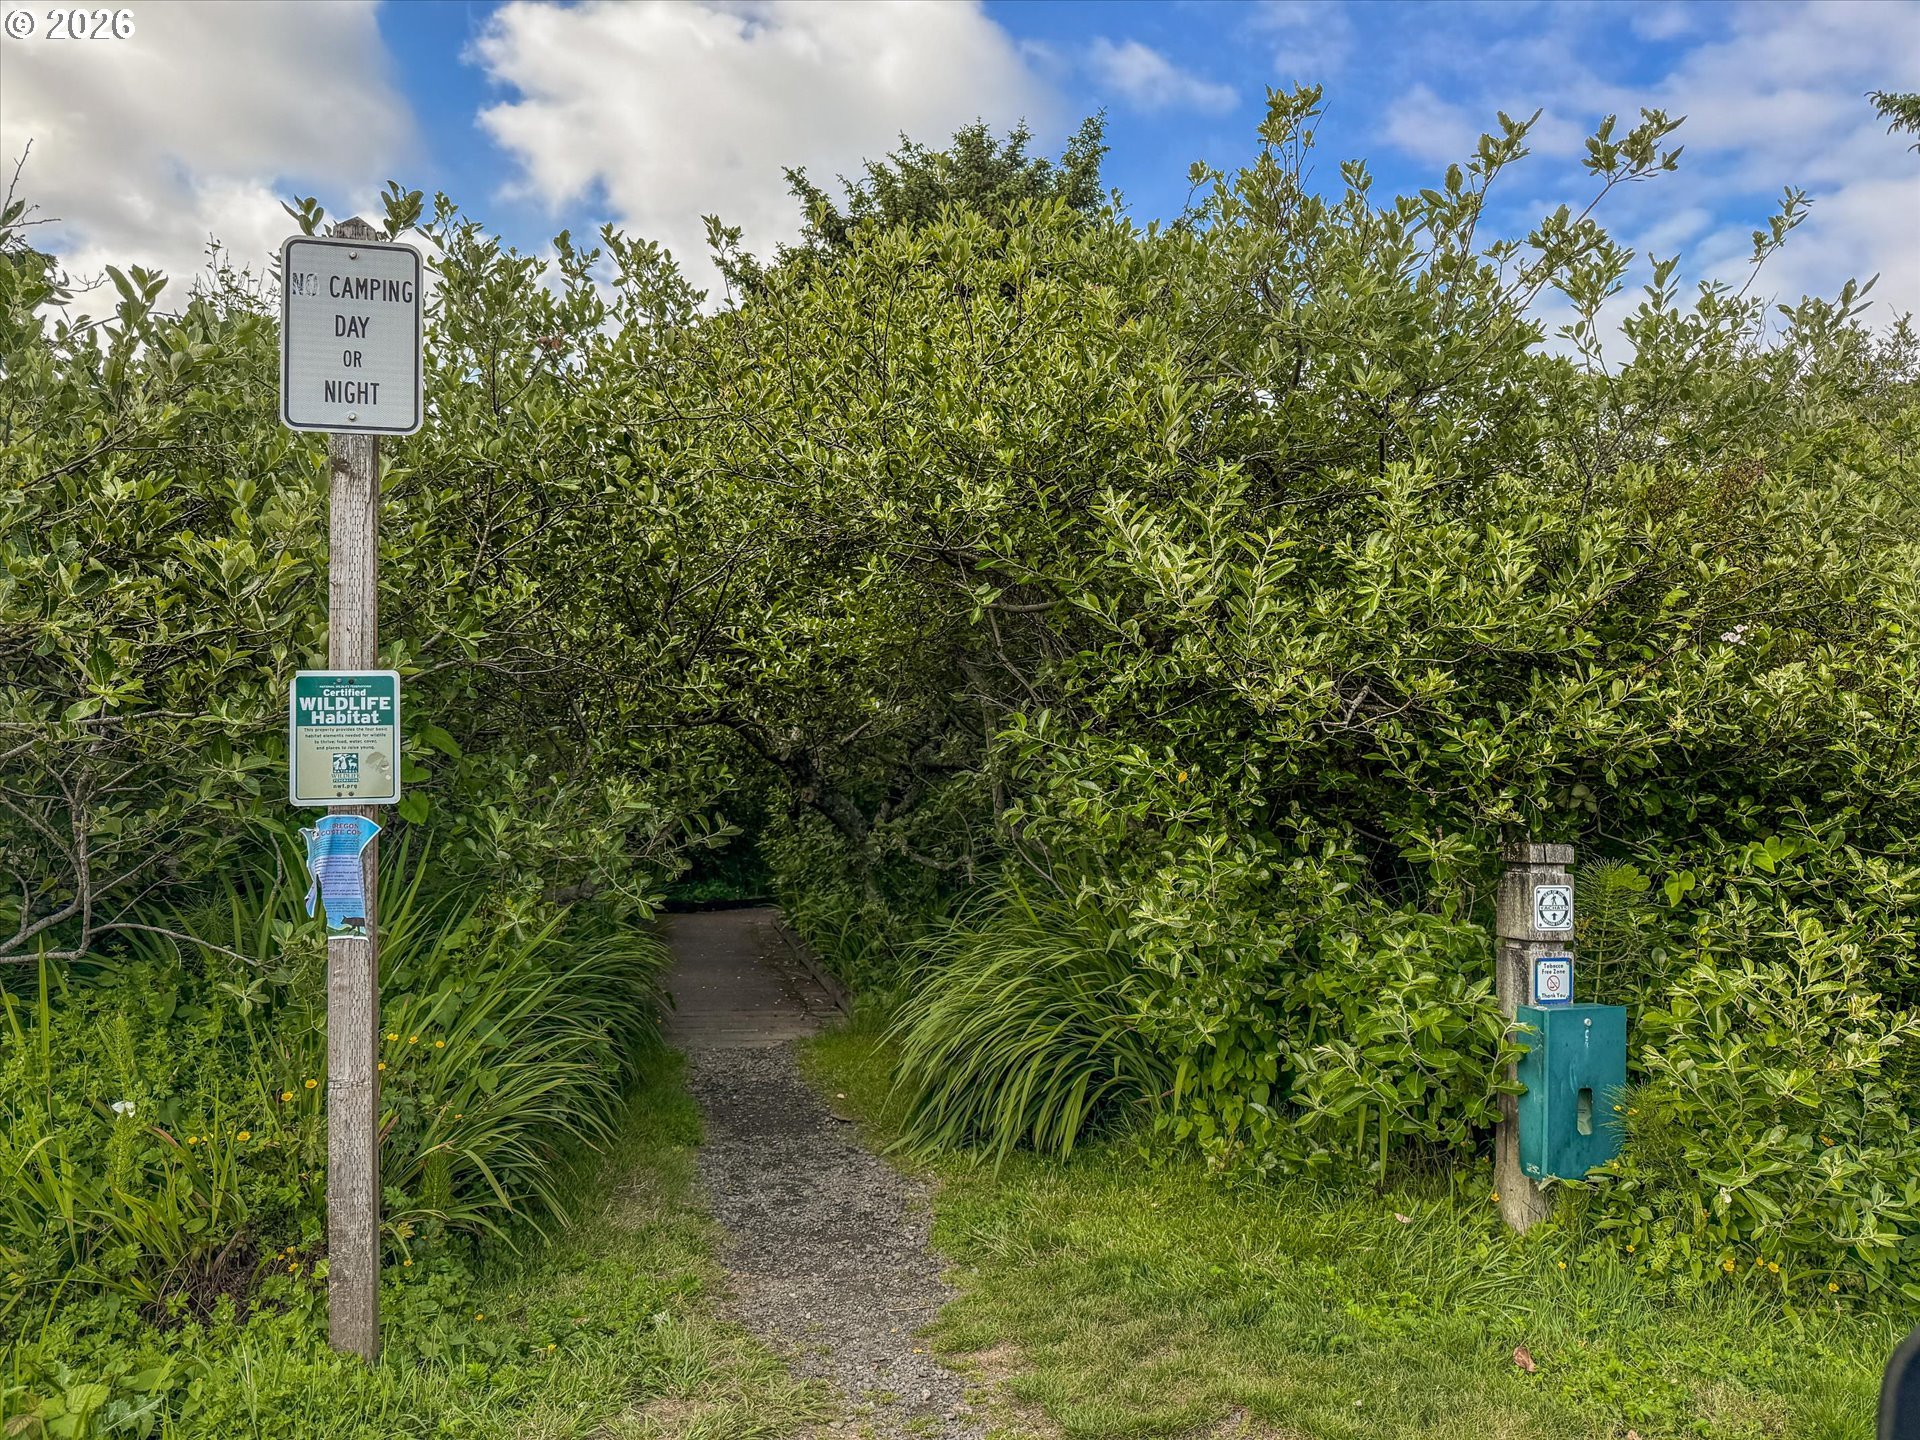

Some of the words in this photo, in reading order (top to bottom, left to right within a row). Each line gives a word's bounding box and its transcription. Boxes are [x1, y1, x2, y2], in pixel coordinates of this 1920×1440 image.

[292, 272, 320, 297] NO
[330, 276, 412, 303] CAMPING
[335, 314, 370, 338] DAY
[343, 350, 362, 367] OR
[324, 380, 380, 405] NIGHT
[323, 688, 366, 697] Certified
[299, 697, 391, 711] WILDLIFE
[312, 710, 379, 724] Habitat
